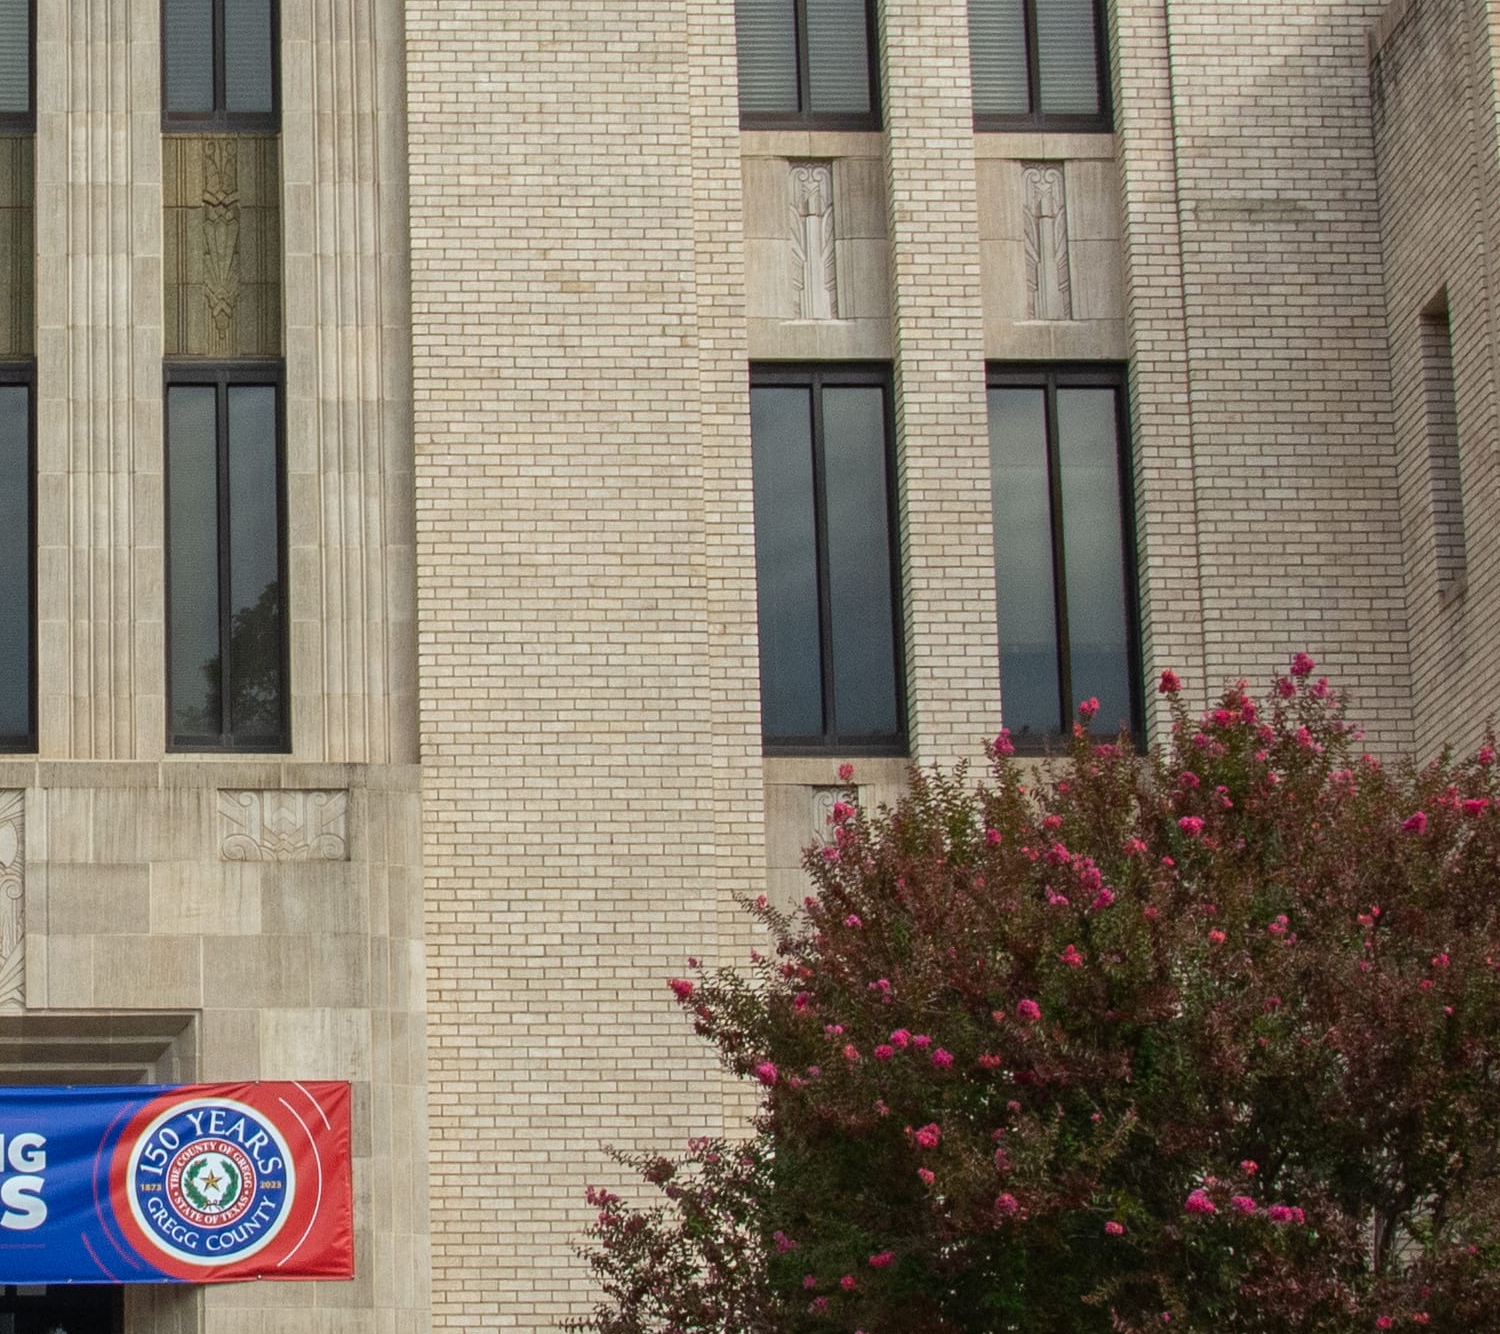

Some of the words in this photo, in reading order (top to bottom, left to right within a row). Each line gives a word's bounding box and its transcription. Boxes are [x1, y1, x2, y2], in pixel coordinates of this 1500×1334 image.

[141, 1128, 180, 1176] 150
[187, 1110, 282, 1175] YEARS
[170, 1167, 180, 1190] THE
[178, 1142, 217, 1163] COUNTY
[218, 1144, 234, 1154] OF
[233, 1152, 253, 1188] GREGG
[260, 1180, 282, 1189] 2023
[140, 1183, 162, 1192] 1873
[147, 1197, 200, 1249] GREGG
[206, 1196, 276, 1251] COUNTY
[174, 1194, 202, 1222] STATE
[204, 1214, 218, 1224] OF
[221, 1195, 249, 1222] TEXAS
